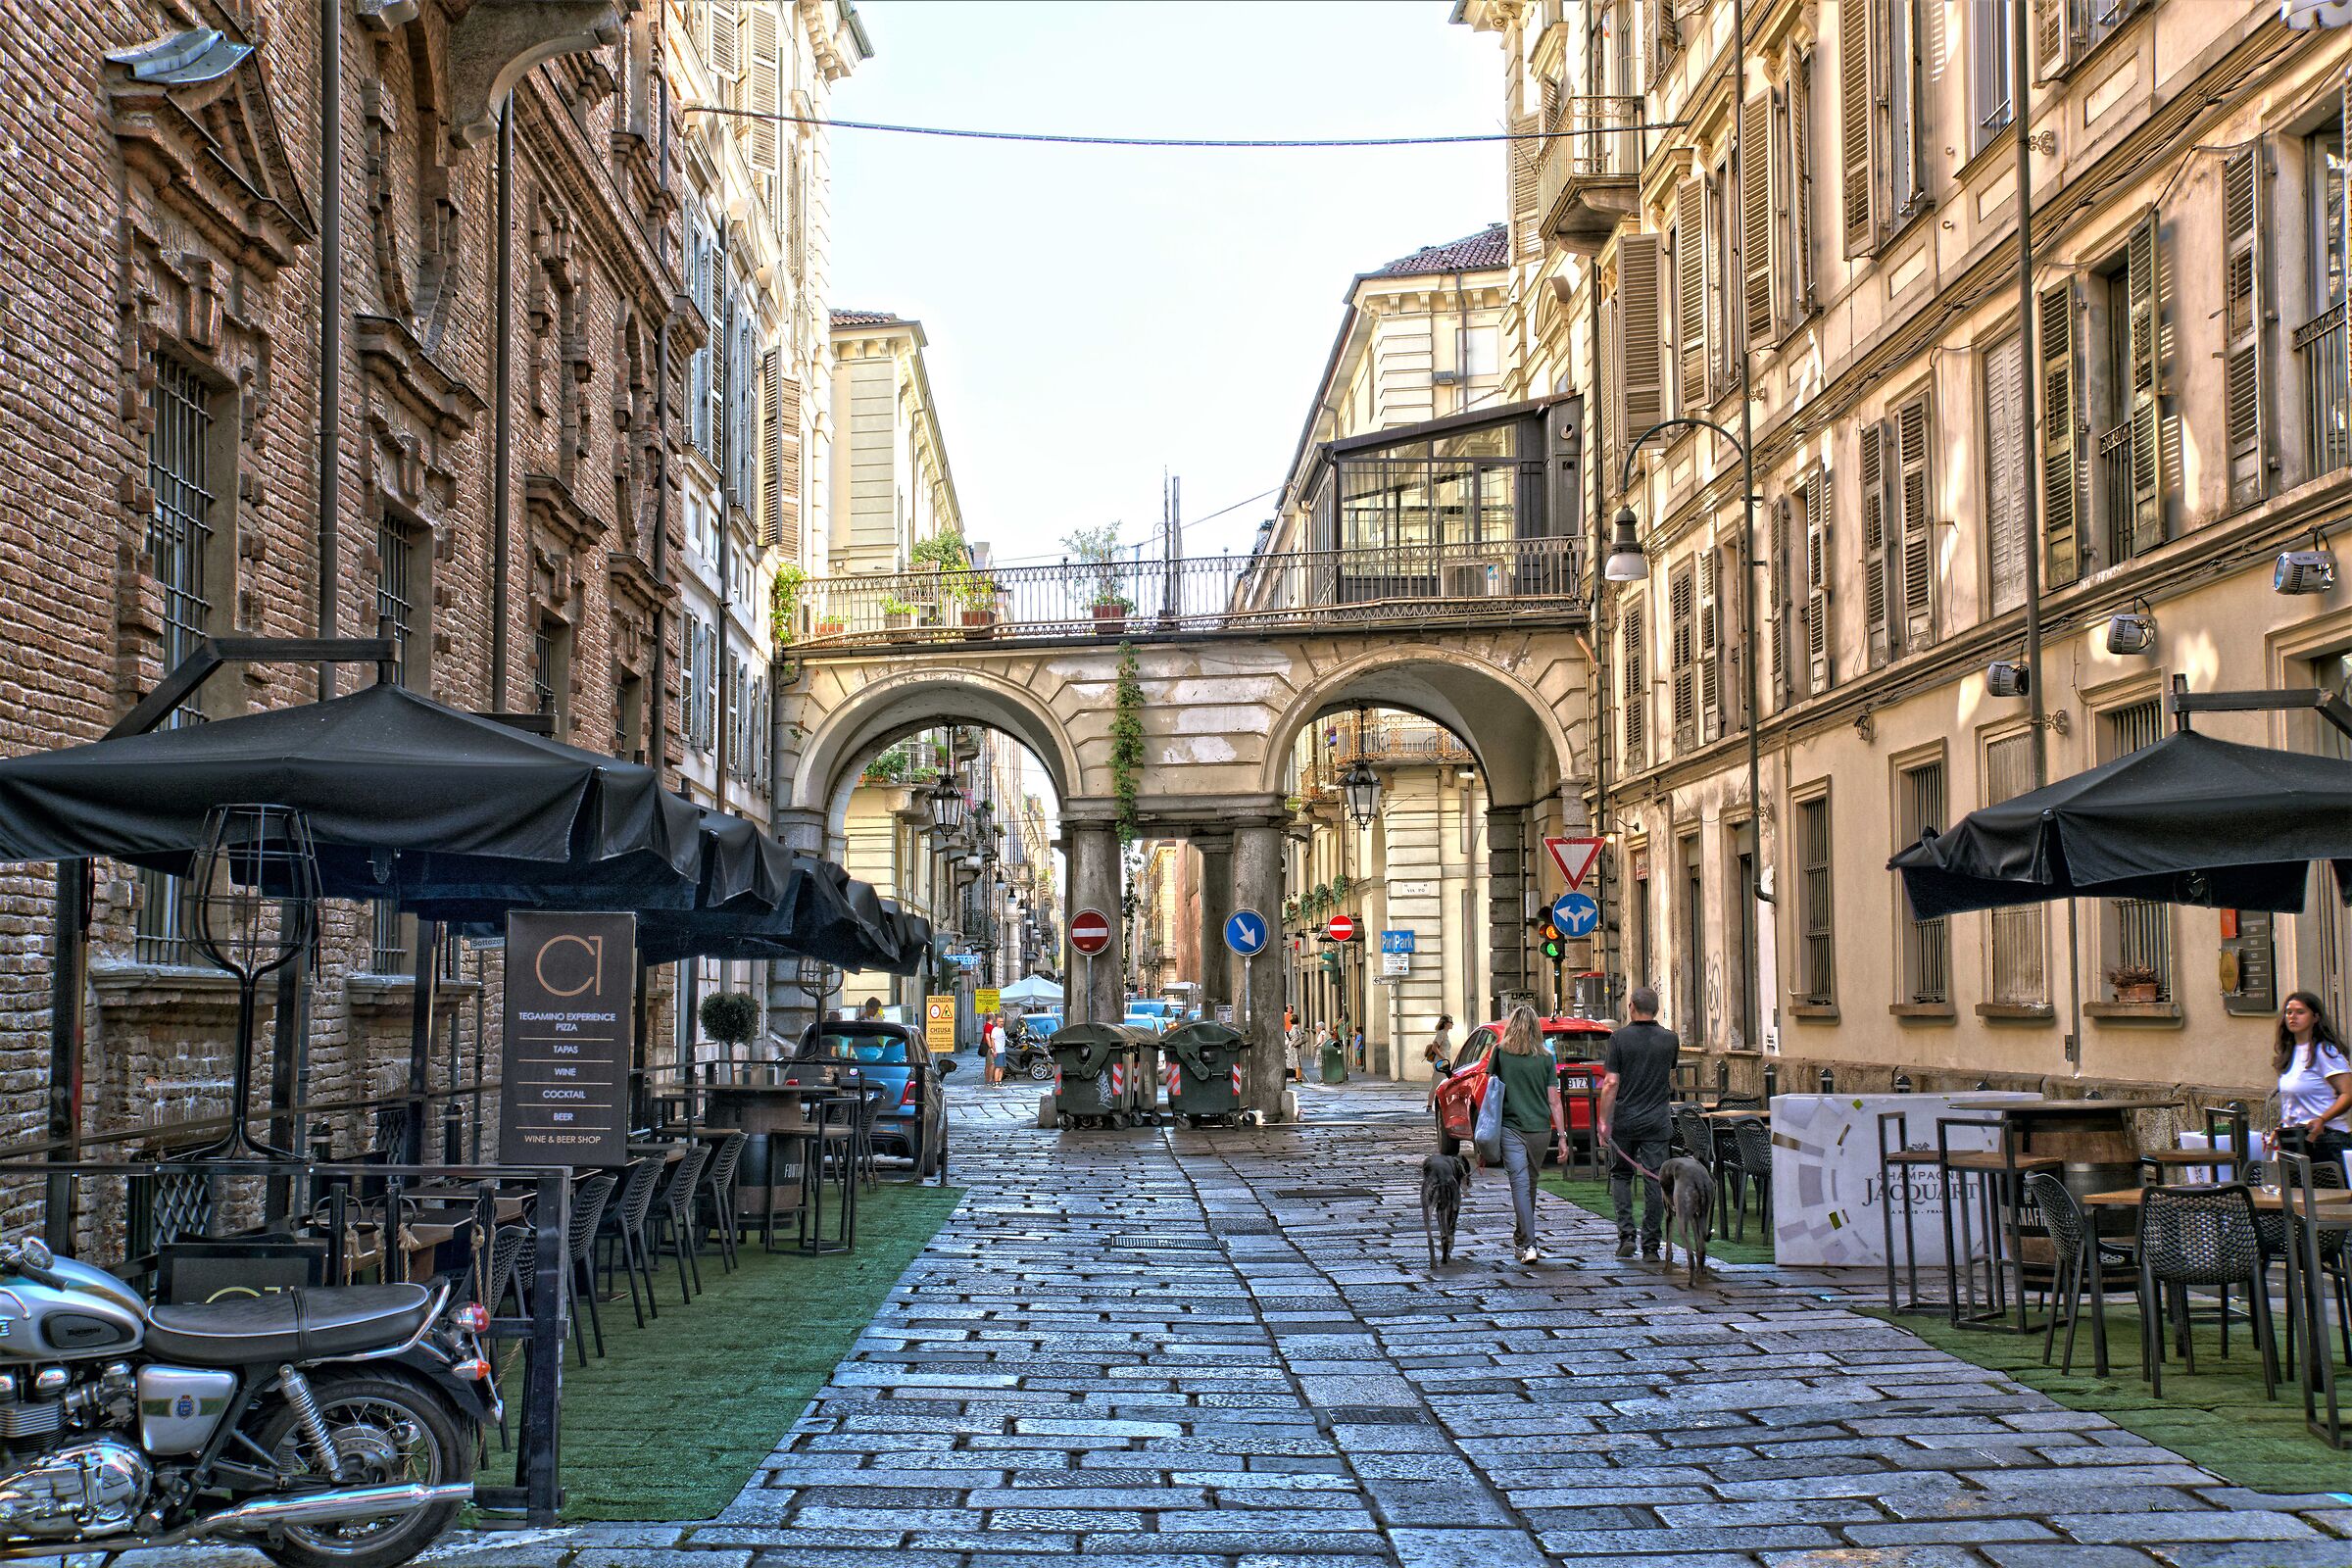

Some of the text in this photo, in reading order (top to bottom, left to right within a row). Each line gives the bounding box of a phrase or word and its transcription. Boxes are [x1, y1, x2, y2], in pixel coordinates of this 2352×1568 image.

[1395, 934, 1413, 950] Park
[553, 1045, 578, 1054] TAPAS
[555, 1067, 576, 1076] WINE
[542, 1090, 586, 1099] COCKTAIL
[554, 1112, 573, 1121] BEER
